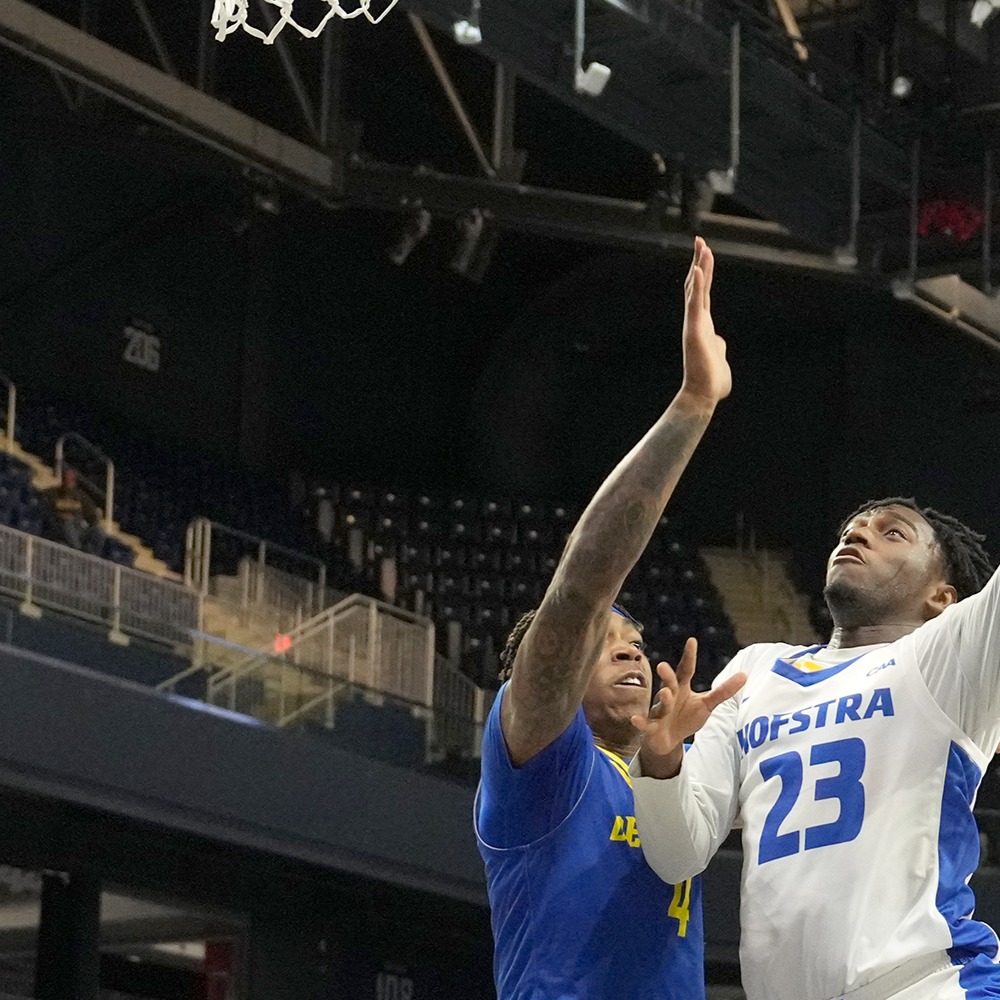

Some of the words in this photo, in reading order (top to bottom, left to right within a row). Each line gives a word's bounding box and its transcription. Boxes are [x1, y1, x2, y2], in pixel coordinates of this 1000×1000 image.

[124, 327, 160, 371] 206
[866, 658, 896, 677] CAA
[736, 687, 895, 755] HOFSTRA
[758, 737, 866, 865] 23
[668, 877, 692, 937] 4
